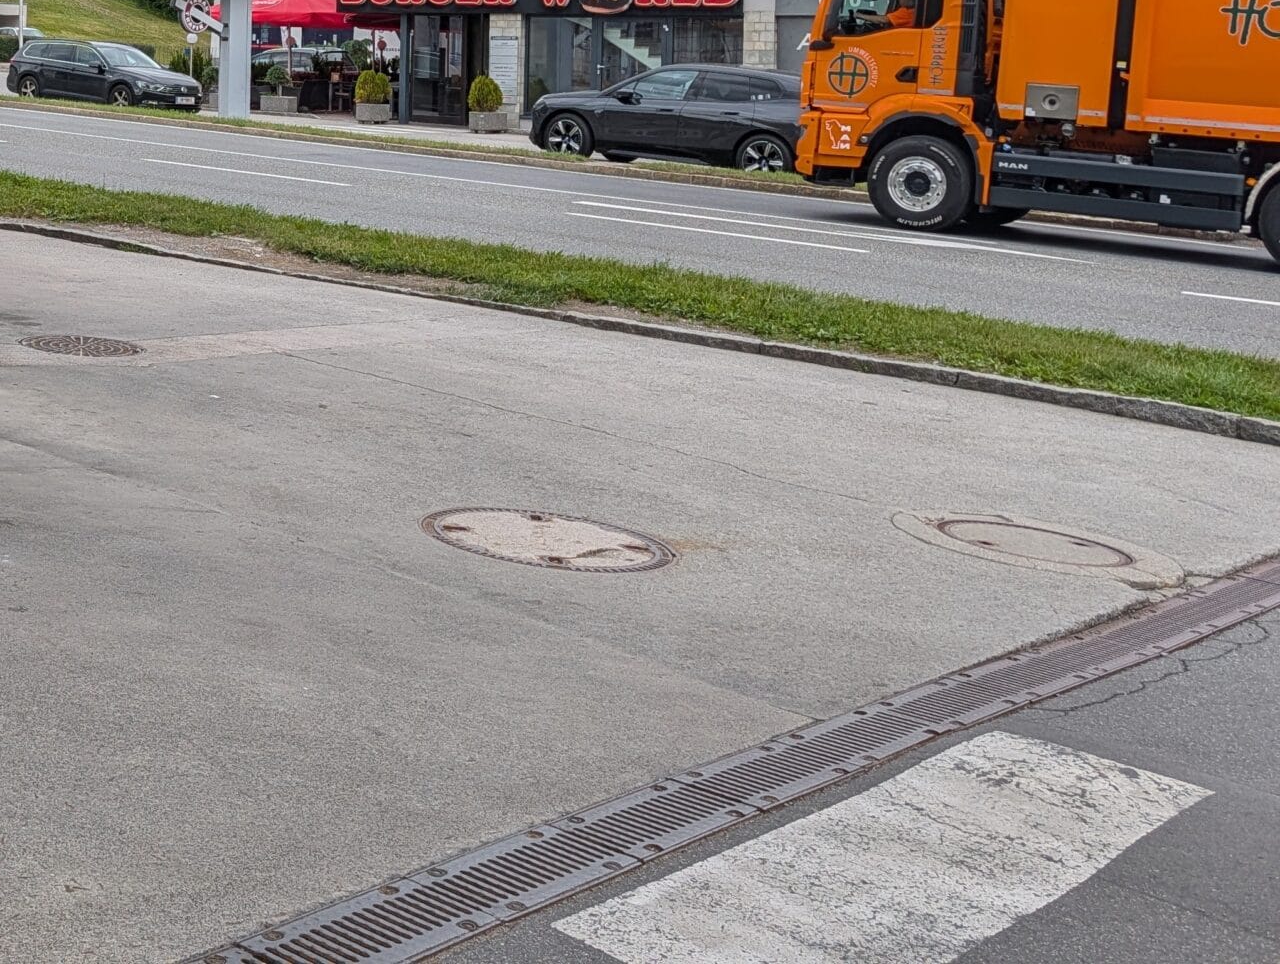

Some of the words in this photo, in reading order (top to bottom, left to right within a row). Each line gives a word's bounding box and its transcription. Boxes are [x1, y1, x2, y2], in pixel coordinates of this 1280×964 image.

[848, 46, 881, 88] UMWELTSCHUTZ
[929, 25, 948, 86] HÖPPERGER
[998, 161, 1028, 170] MAN
